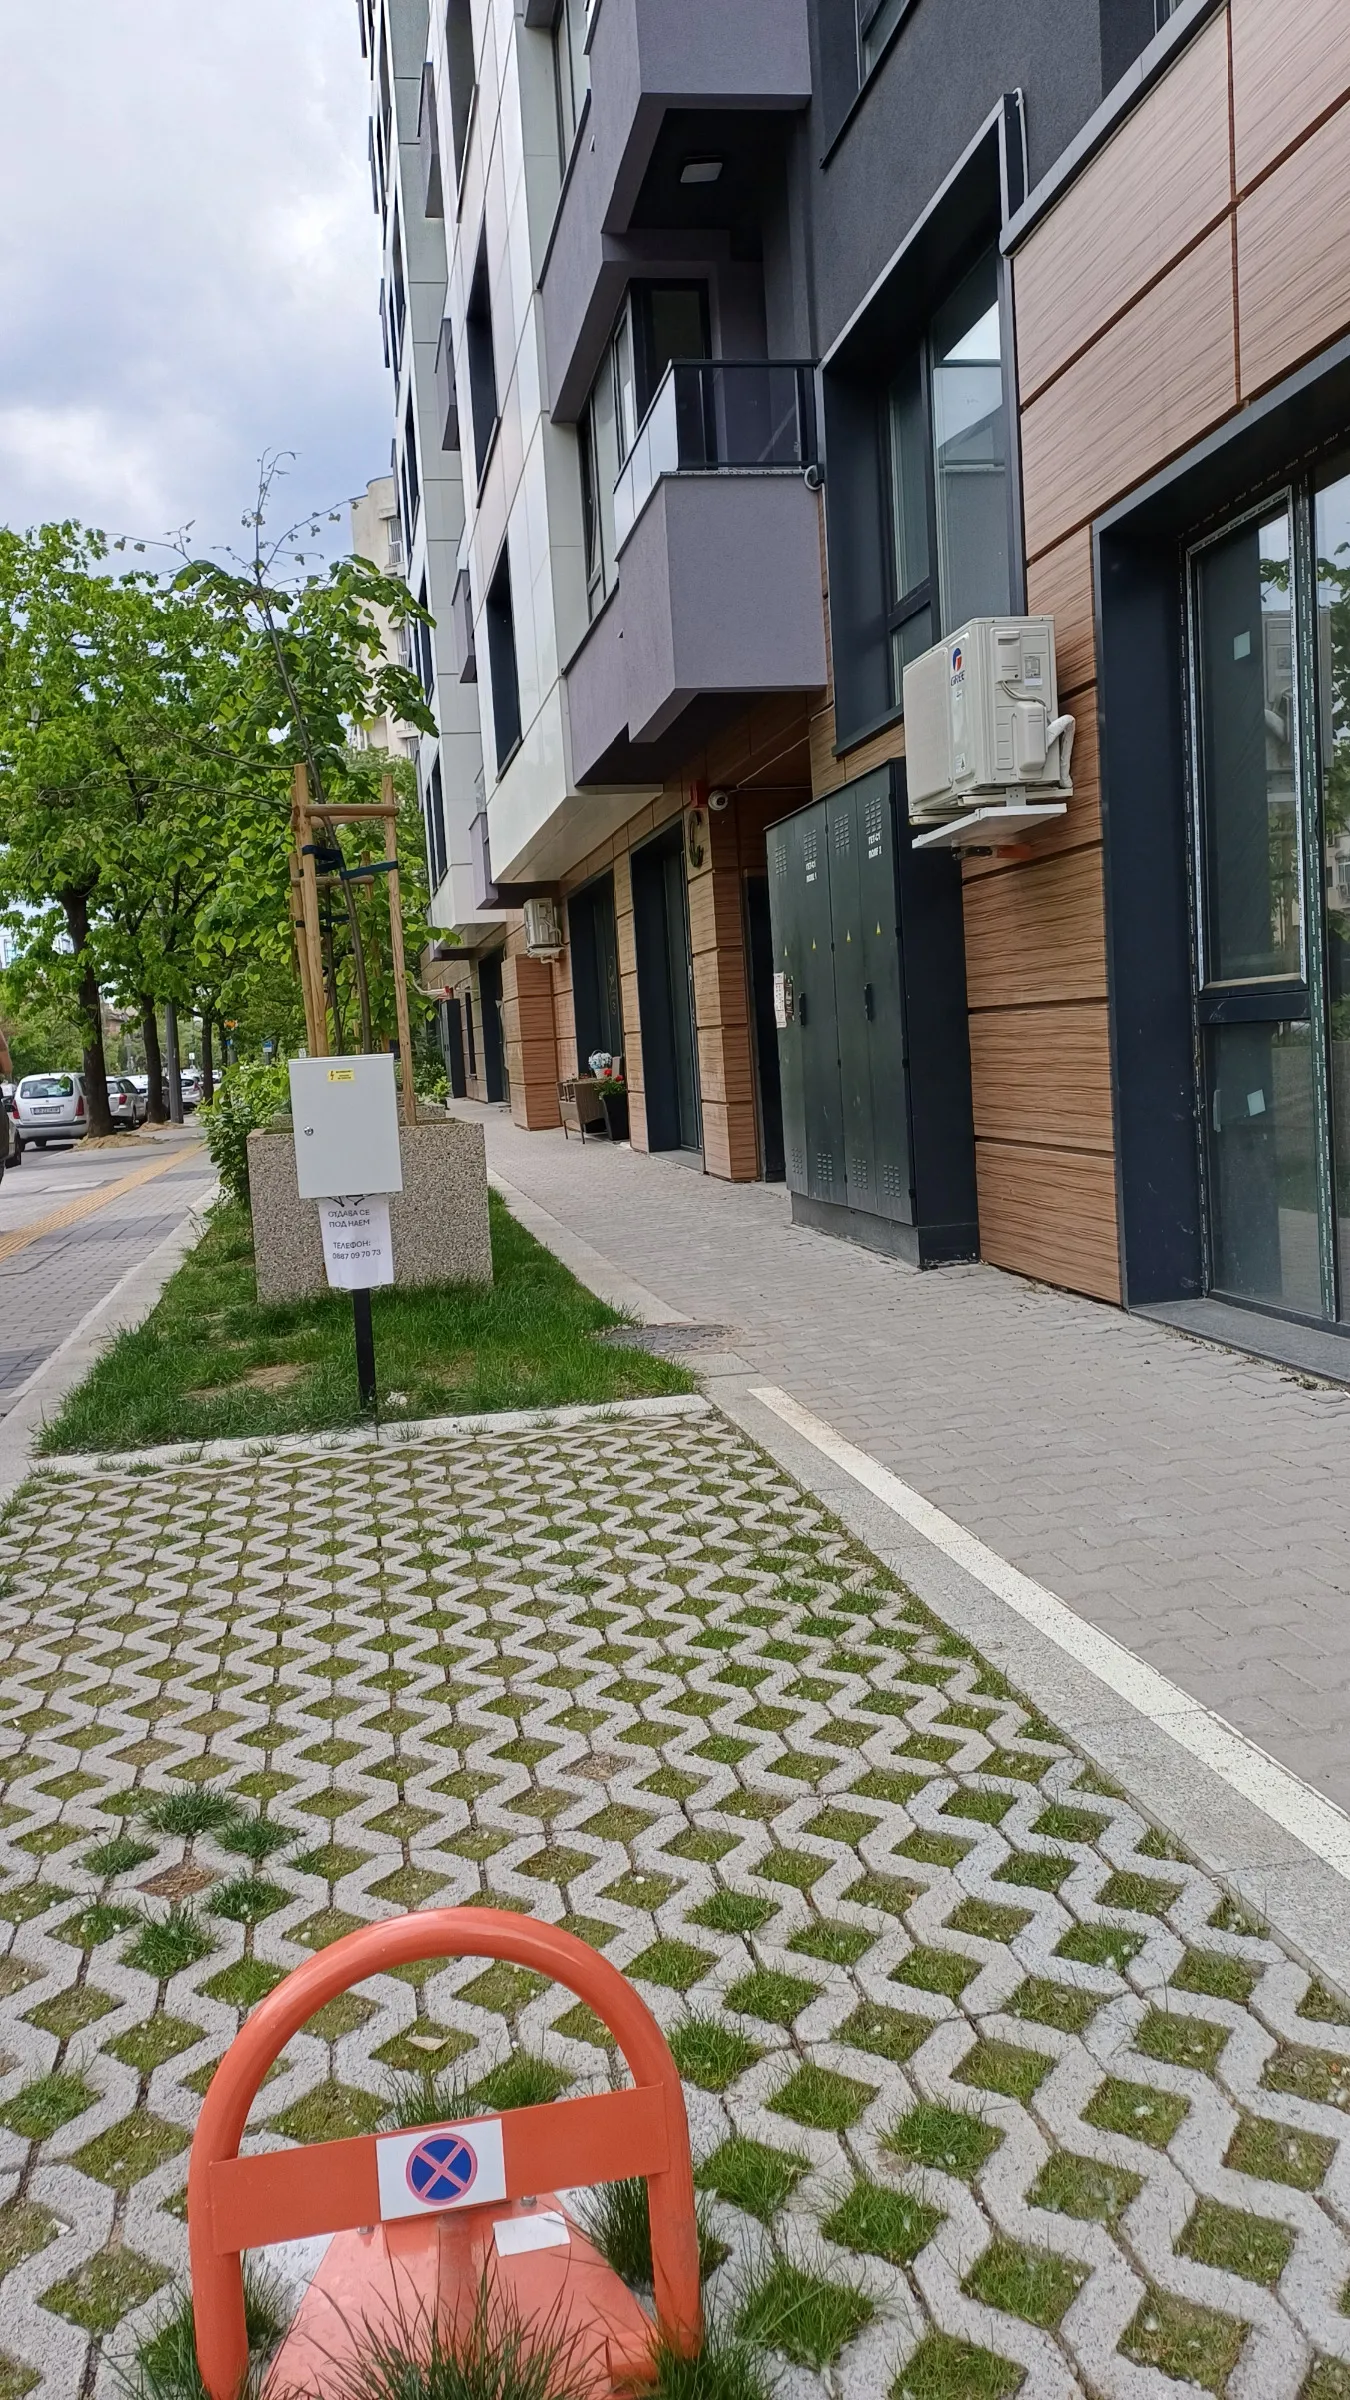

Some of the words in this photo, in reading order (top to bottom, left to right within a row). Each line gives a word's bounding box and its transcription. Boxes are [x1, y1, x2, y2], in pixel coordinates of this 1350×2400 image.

[951, 670, 965, 686] GREE
[328, 1210, 358, 1218] ОТДАВА
[348, 1219, 370, 1227] НАЕМ
[333, 1240, 371, 1249] ТЕЛЕФОН:
[361, 1250, 371, 1258] 70
